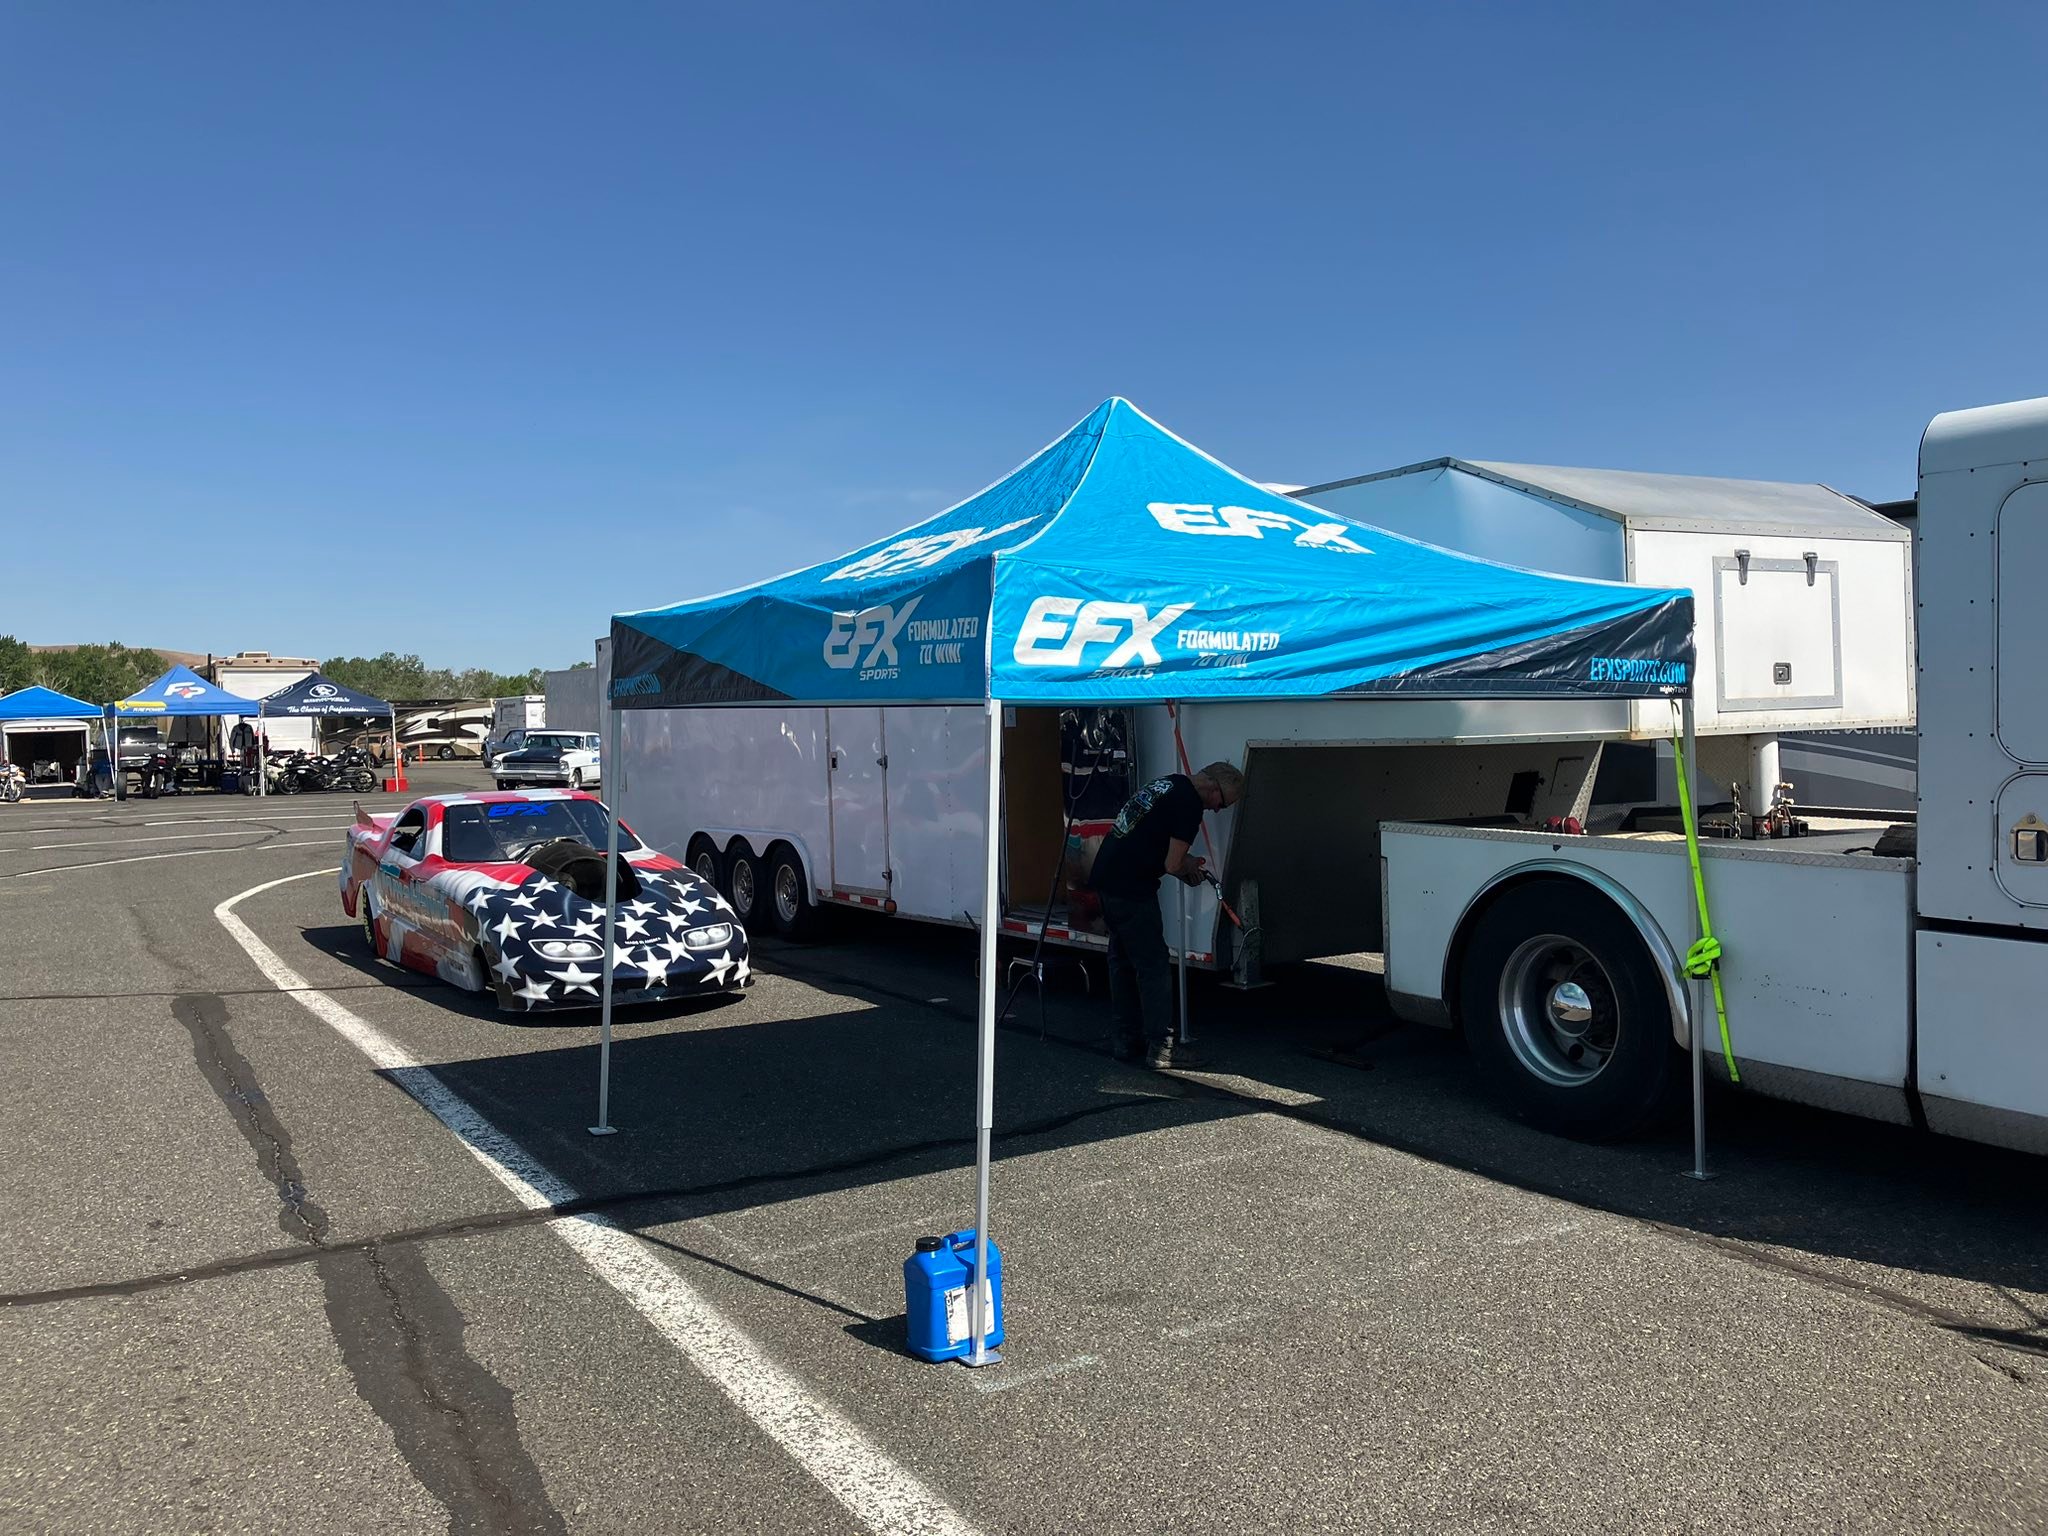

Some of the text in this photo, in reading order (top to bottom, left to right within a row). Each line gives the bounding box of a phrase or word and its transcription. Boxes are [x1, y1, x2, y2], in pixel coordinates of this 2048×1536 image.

[1146, 502, 1377, 555] EFX
[823, 594, 925, 669] EFX
[907, 616, 979, 642] FORMULATED
[1013, 595, 1197, 668] EFX
[1177, 629, 1281, 652] FORMULATED
[919, 642, 962, 665] TO WIN!
[858, 668, 899, 682] SPORTS
[1087, 666, 1156, 680] SPORTS
[1590, 657, 1687, 685] EFXSPORTS.COM
[487, 803, 556, 818] EFX
